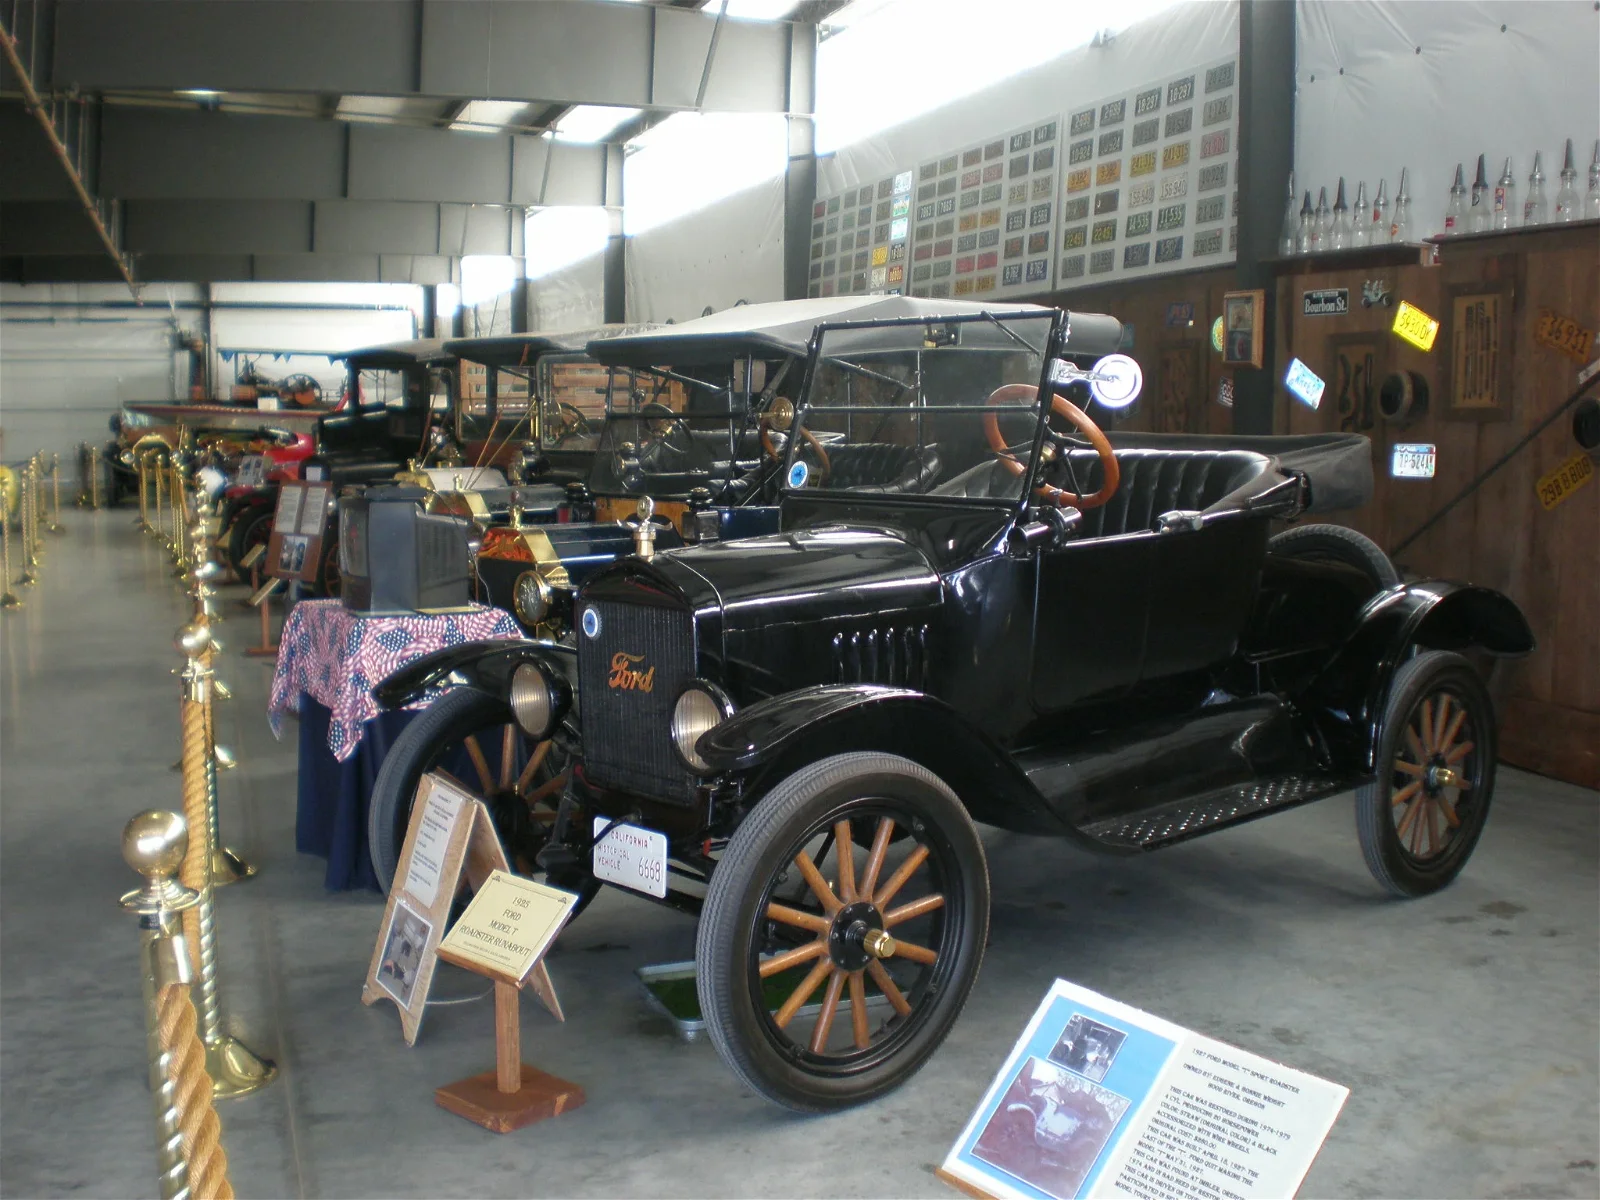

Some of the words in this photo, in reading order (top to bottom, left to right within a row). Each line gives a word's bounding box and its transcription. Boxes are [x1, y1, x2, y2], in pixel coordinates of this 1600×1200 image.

[1305, 297, 1335, 313] Bourbon
[1337, 297, 1347, 312] St.
[609, 651, 655, 693] Ford
[611, 830, 648, 849] CALIFORNIA
[598, 857, 621, 871] VEHICLE
[638, 857, 661, 883] 6668
[502, 909, 522, 920] FORD
[512, 896, 530, 909] 1925
[459, 925, 495, 944] ROADSTER
[493, 937, 531, 956] RUNABOUT
[490, 920, 511, 934] MODEL
[512, 927, 519, 936] T
[1183, 1063, 1203, 1074] OWNED
[1263, 1094, 1285, 1108] WRIGHT
[1206, 1054, 1222, 1063] FORD
[1221, 1059, 1240, 1071] MODEL
[1250, 1070, 1269, 1082] SPORT
[1269, 1078, 1300, 1094] ROADSTER
[1170, 1085, 1183, 1095] THIS
[1208, 1102, 1237, 1118] RESTORED
[1237, 1114, 1259, 1127] DURING
[1207, 1082, 1223, 1093] HOOD
[1242, 1096, 1266, 1110] OREGON
[1152, 1117, 1177, 1133] ORIGINAL
[1156, 1110, 1196, 1131] ACCESSORIZED
[1197, 1127, 1212, 1138] WITH
[1211, 1133, 1227, 1144] WIRE
[1179, 1110, 1200, 1122] STRAW
[1257, 1143, 1278, 1156] BLACK
[1182, 1101, 1213, 1118] PRODUCING
[1221, 1118, 1259, 1138] HORSEPOWER
[1137, 1140, 1155, 1153] MODEL
[1142, 1132, 1157, 1144] LAST
[1188, 1153, 1205, 1164] FORD
[1204, 1160, 1218, 1171] QUIT
[1218, 1166, 1241, 1181] MAKING
[1147, 1124, 1160, 1135] THIS
[1185, 1142, 1202, 1153] BUILT
[1201, 1150, 1219, 1161] APRIL
[1133, 1148, 1146, 1158] THIS
[1171, 1166, 1190, 1178] FOUND
[1114, 1180, 1132, 1194] MODEL
[1119, 1172, 1159, 1195] PARTICIPATED
[1124, 1164, 1137, 1175] THIS
[1155, 1179, 1176, 1193] DRIVEN
[1173, 1177, 1190, 1189] NEED
